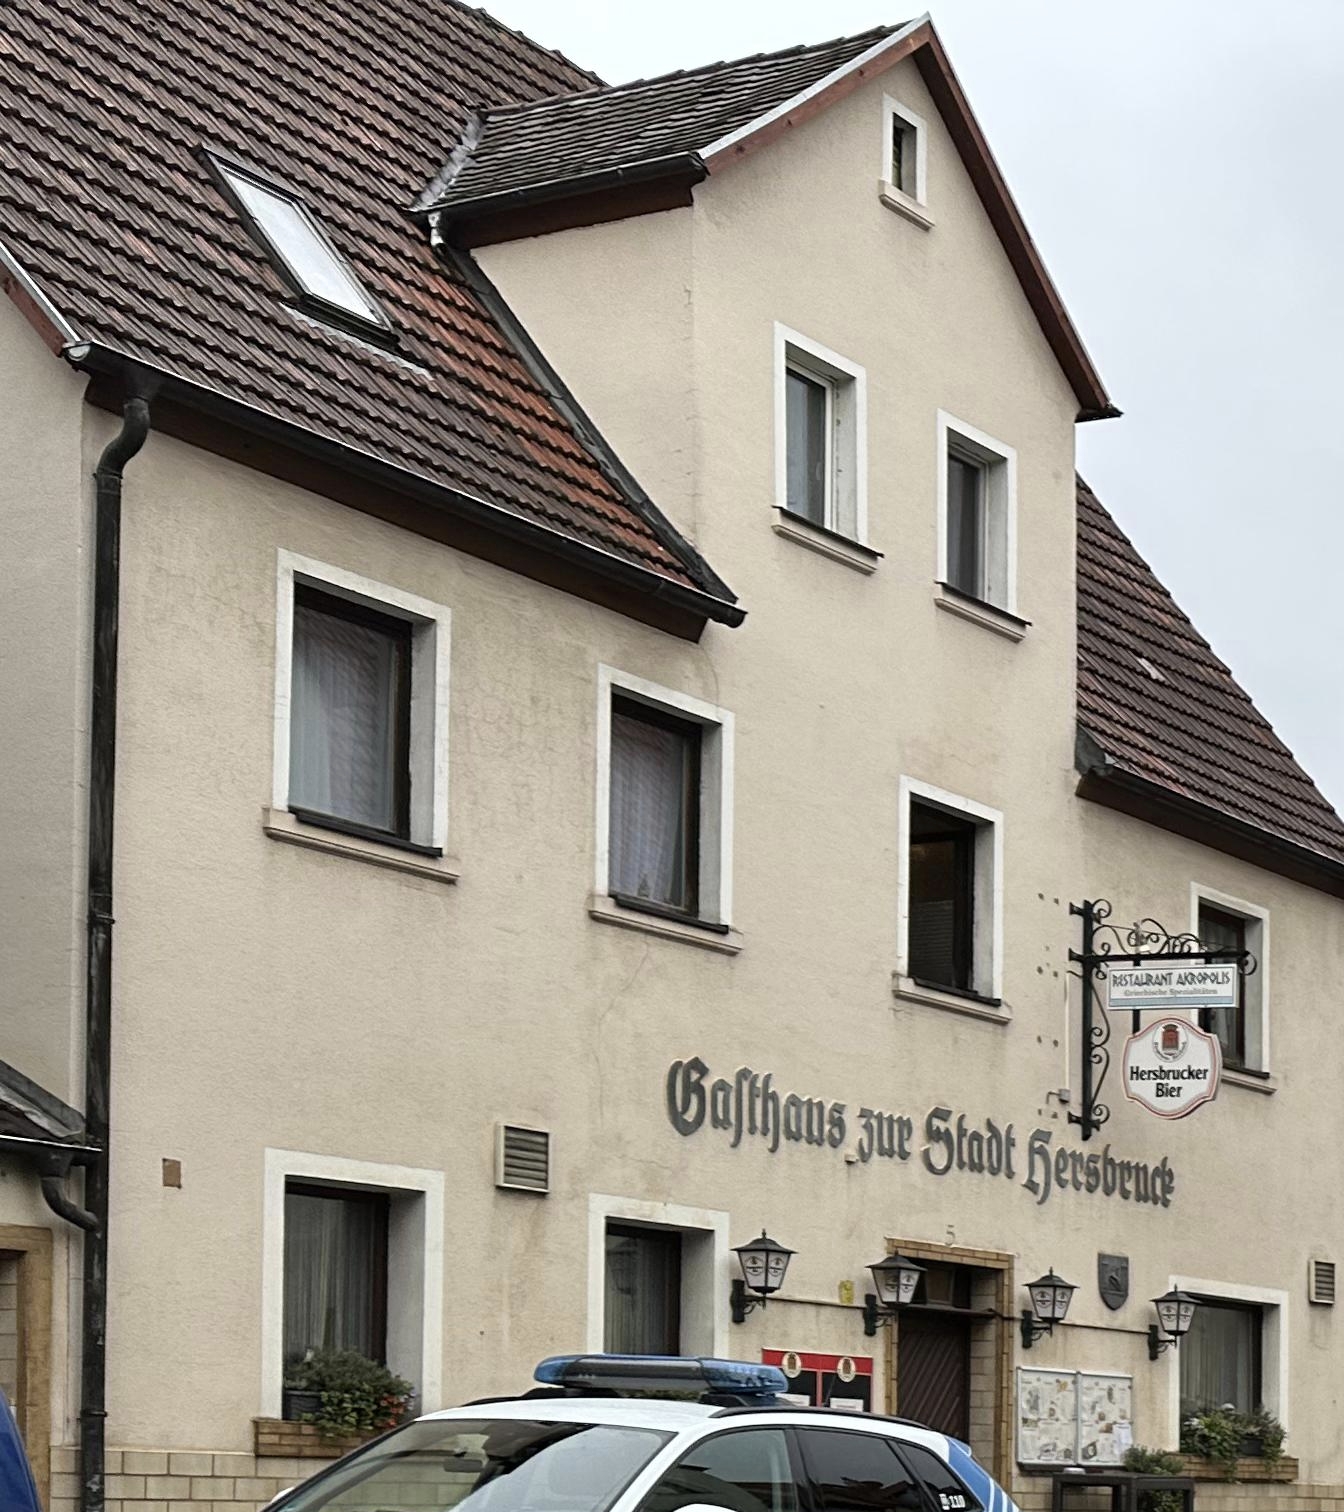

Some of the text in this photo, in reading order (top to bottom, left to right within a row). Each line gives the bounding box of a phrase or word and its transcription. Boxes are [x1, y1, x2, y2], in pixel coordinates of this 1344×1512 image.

[1112, 971, 1231, 987] RESTAURANT AKROPOLIS
[1130, 1065, 1209, 1081] Hersbrucker
[1155, 1083, 1183, 1098] Bier
[857, 1107, 913, 1163] zur
[921, 1106, 1016, 1180] Stadt
[1022, 1128, 1175, 1208] Hersbruck
[945, 1224, 956, 1247] 5
